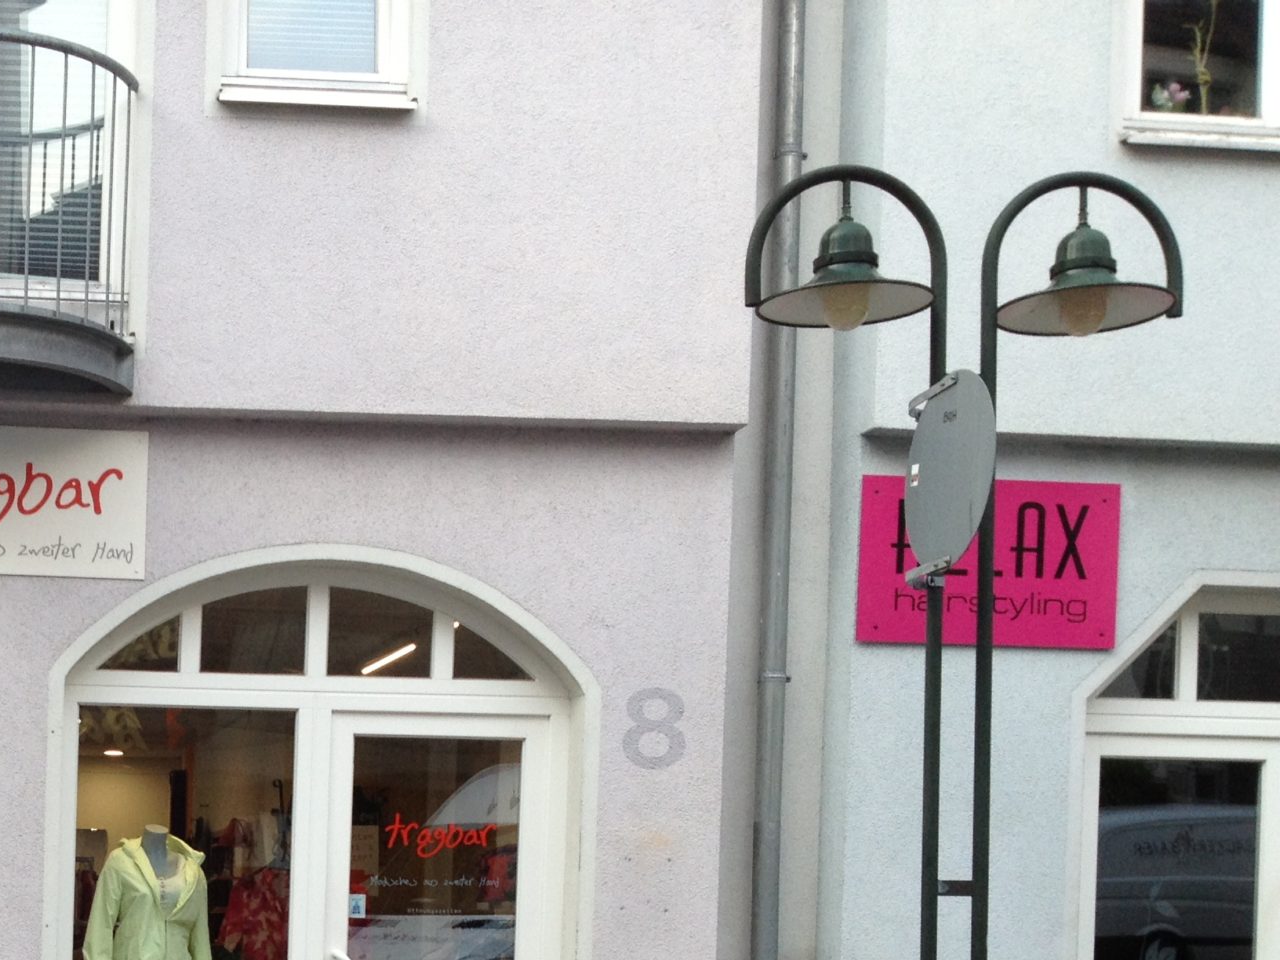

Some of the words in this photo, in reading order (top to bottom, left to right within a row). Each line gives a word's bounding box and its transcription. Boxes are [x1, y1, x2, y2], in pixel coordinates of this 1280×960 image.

[17, 535, 81, 561] zweiter
[92, 541, 134, 564] Hand
[894, 588, 1087, 624] harstyling
[623, 687, 686, 770] 8
[385, 812, 497, 858] tragbar
